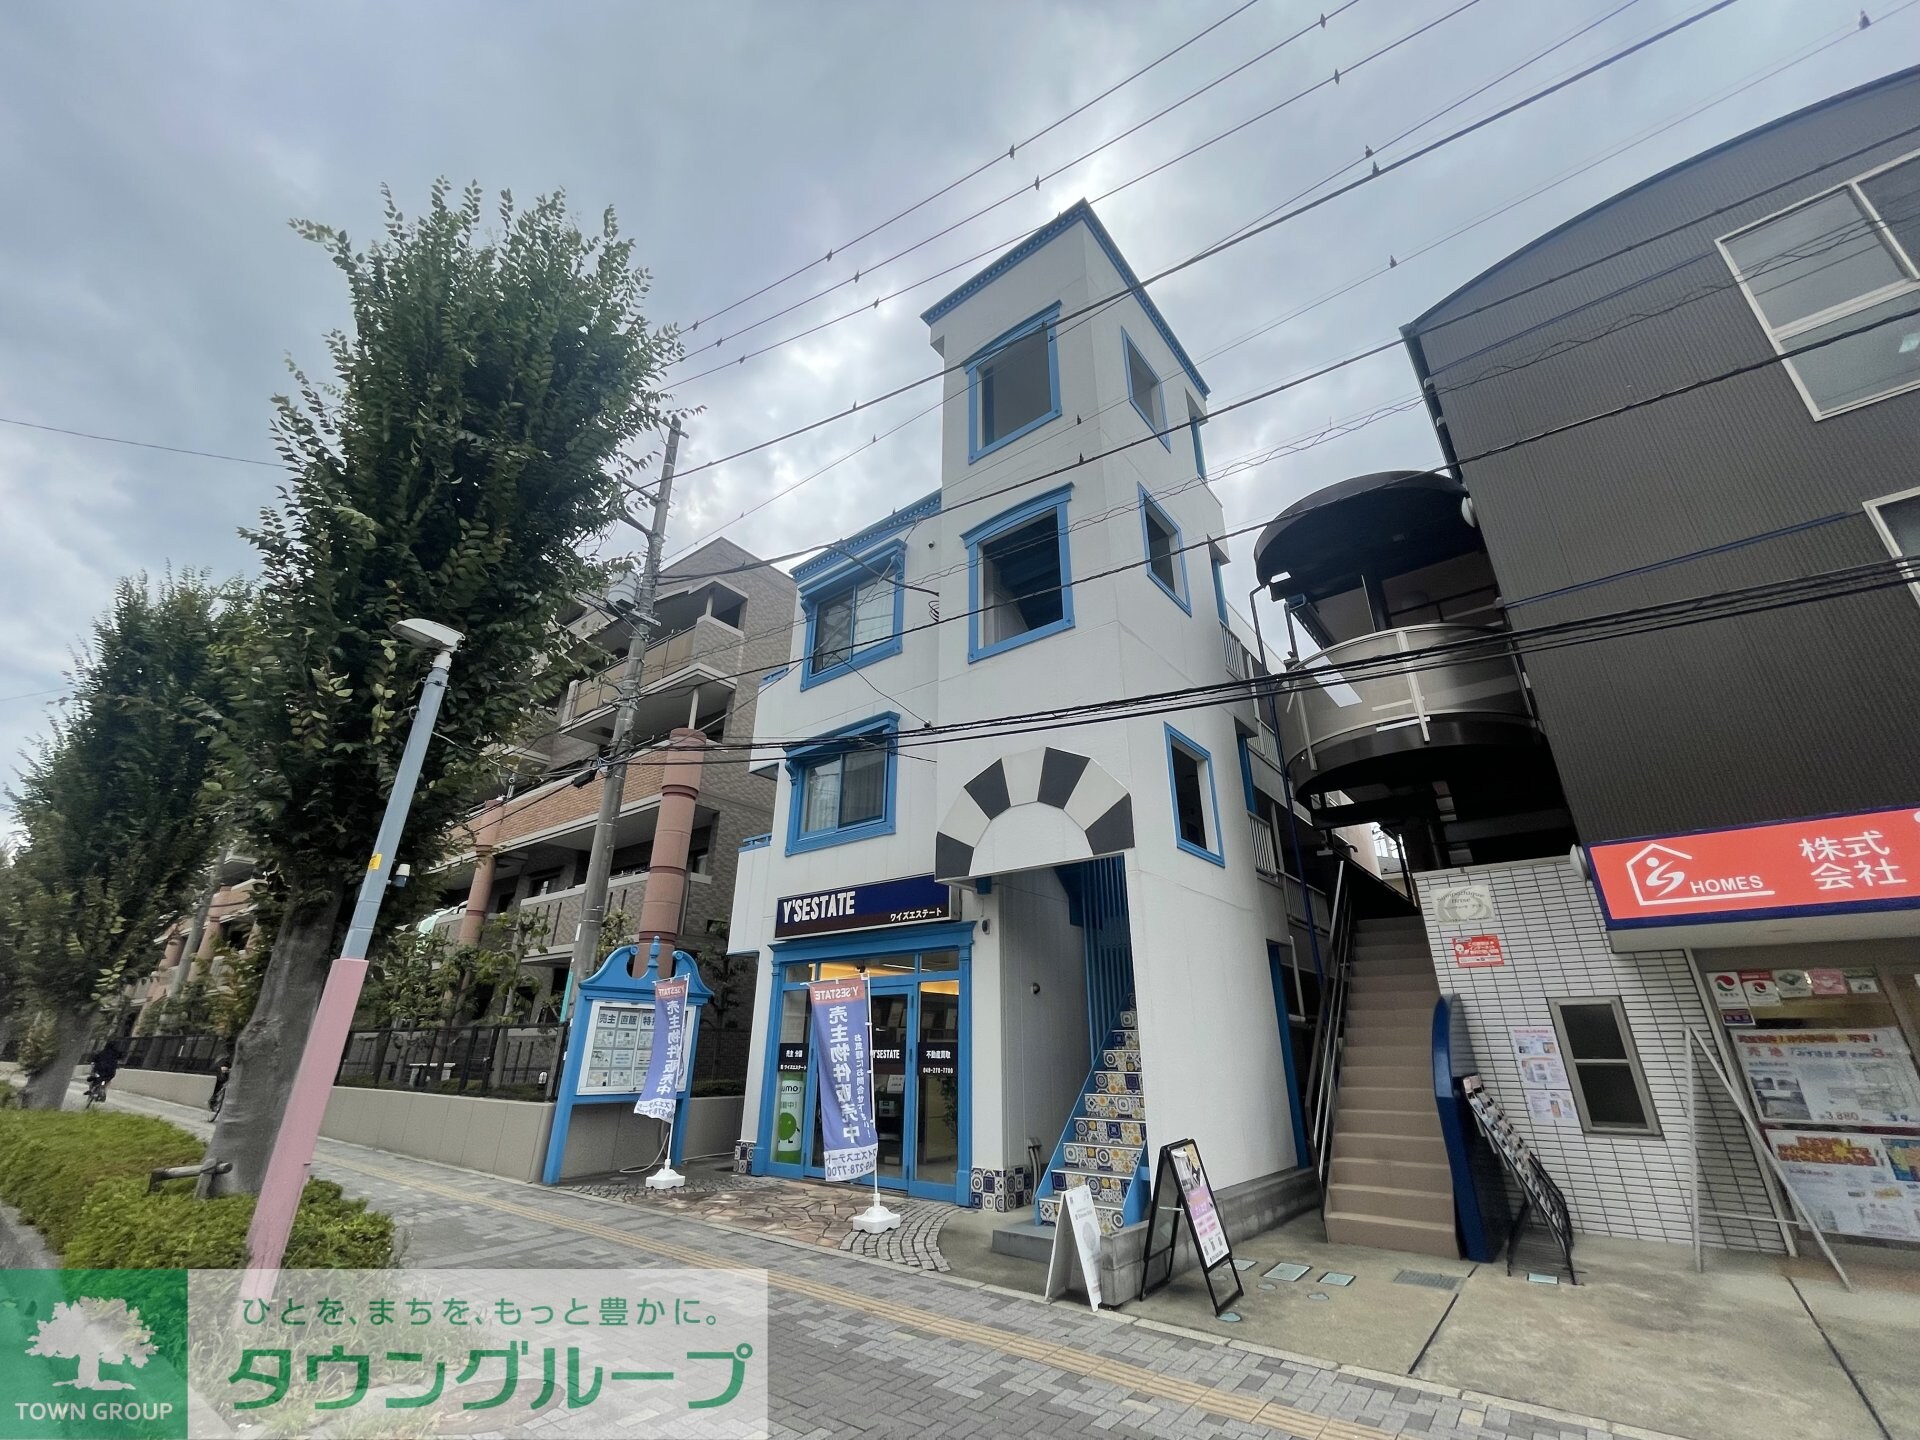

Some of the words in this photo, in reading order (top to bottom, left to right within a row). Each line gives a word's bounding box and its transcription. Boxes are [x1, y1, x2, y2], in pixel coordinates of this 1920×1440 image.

[1798, 830, 1891, 863] 株式
[1689, 875, 1765, 894] HOMES
[1810, 858, 1907, 890] 会社
[783, 890, 856, 923] Y'SESTATE
[890, 907, 942, 922] ワイズエステート
